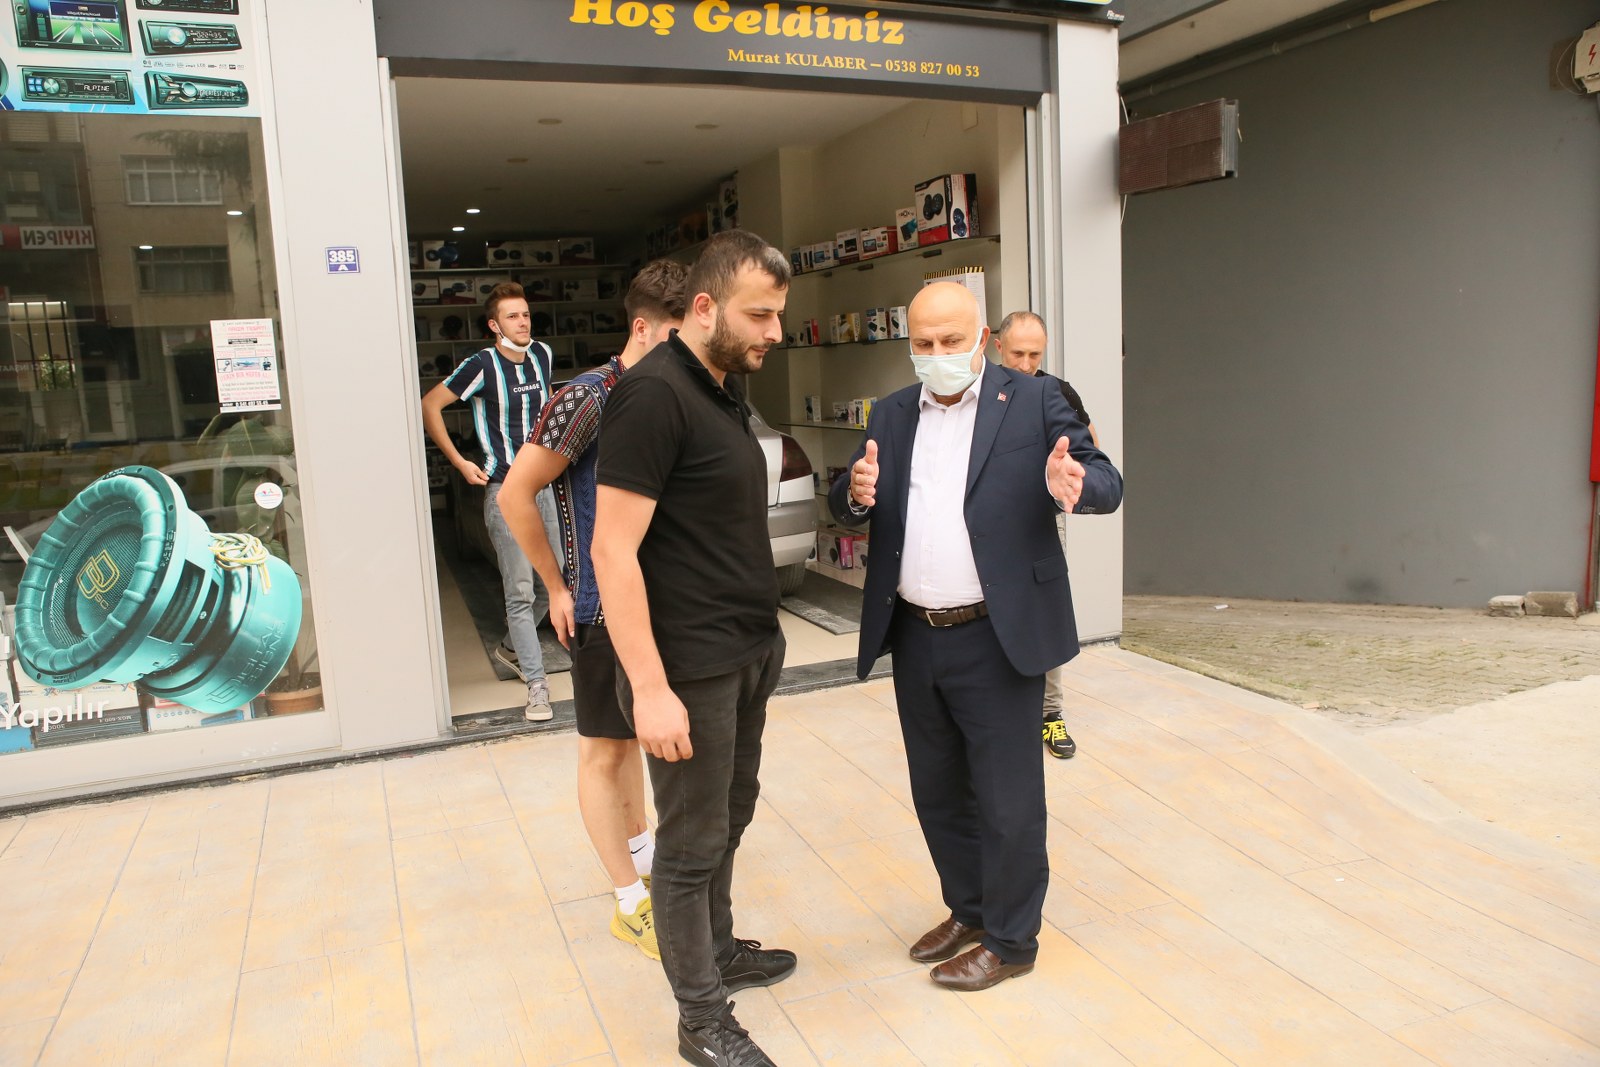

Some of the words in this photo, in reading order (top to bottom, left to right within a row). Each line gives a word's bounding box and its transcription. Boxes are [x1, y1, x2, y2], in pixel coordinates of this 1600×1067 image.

[569, 0, 675, 35] Hoş
[693, 0, 905, 45] Geldiniz
[728, 48, 780, 67] Murat
[785, 52, 867, 72] KULABER
[885, 59, 917, 75] 0538
[921, 62, 943, 76] 827
[946, 63, 963, 77] 00
[965, 65, 981, 78] 53
[83, 84, 110, 92] ALPINE
[329, 250, 355, 263] 385
[513, 383, 540, 393] COURAGE
[0, 693, 110, 733] Yapılır
